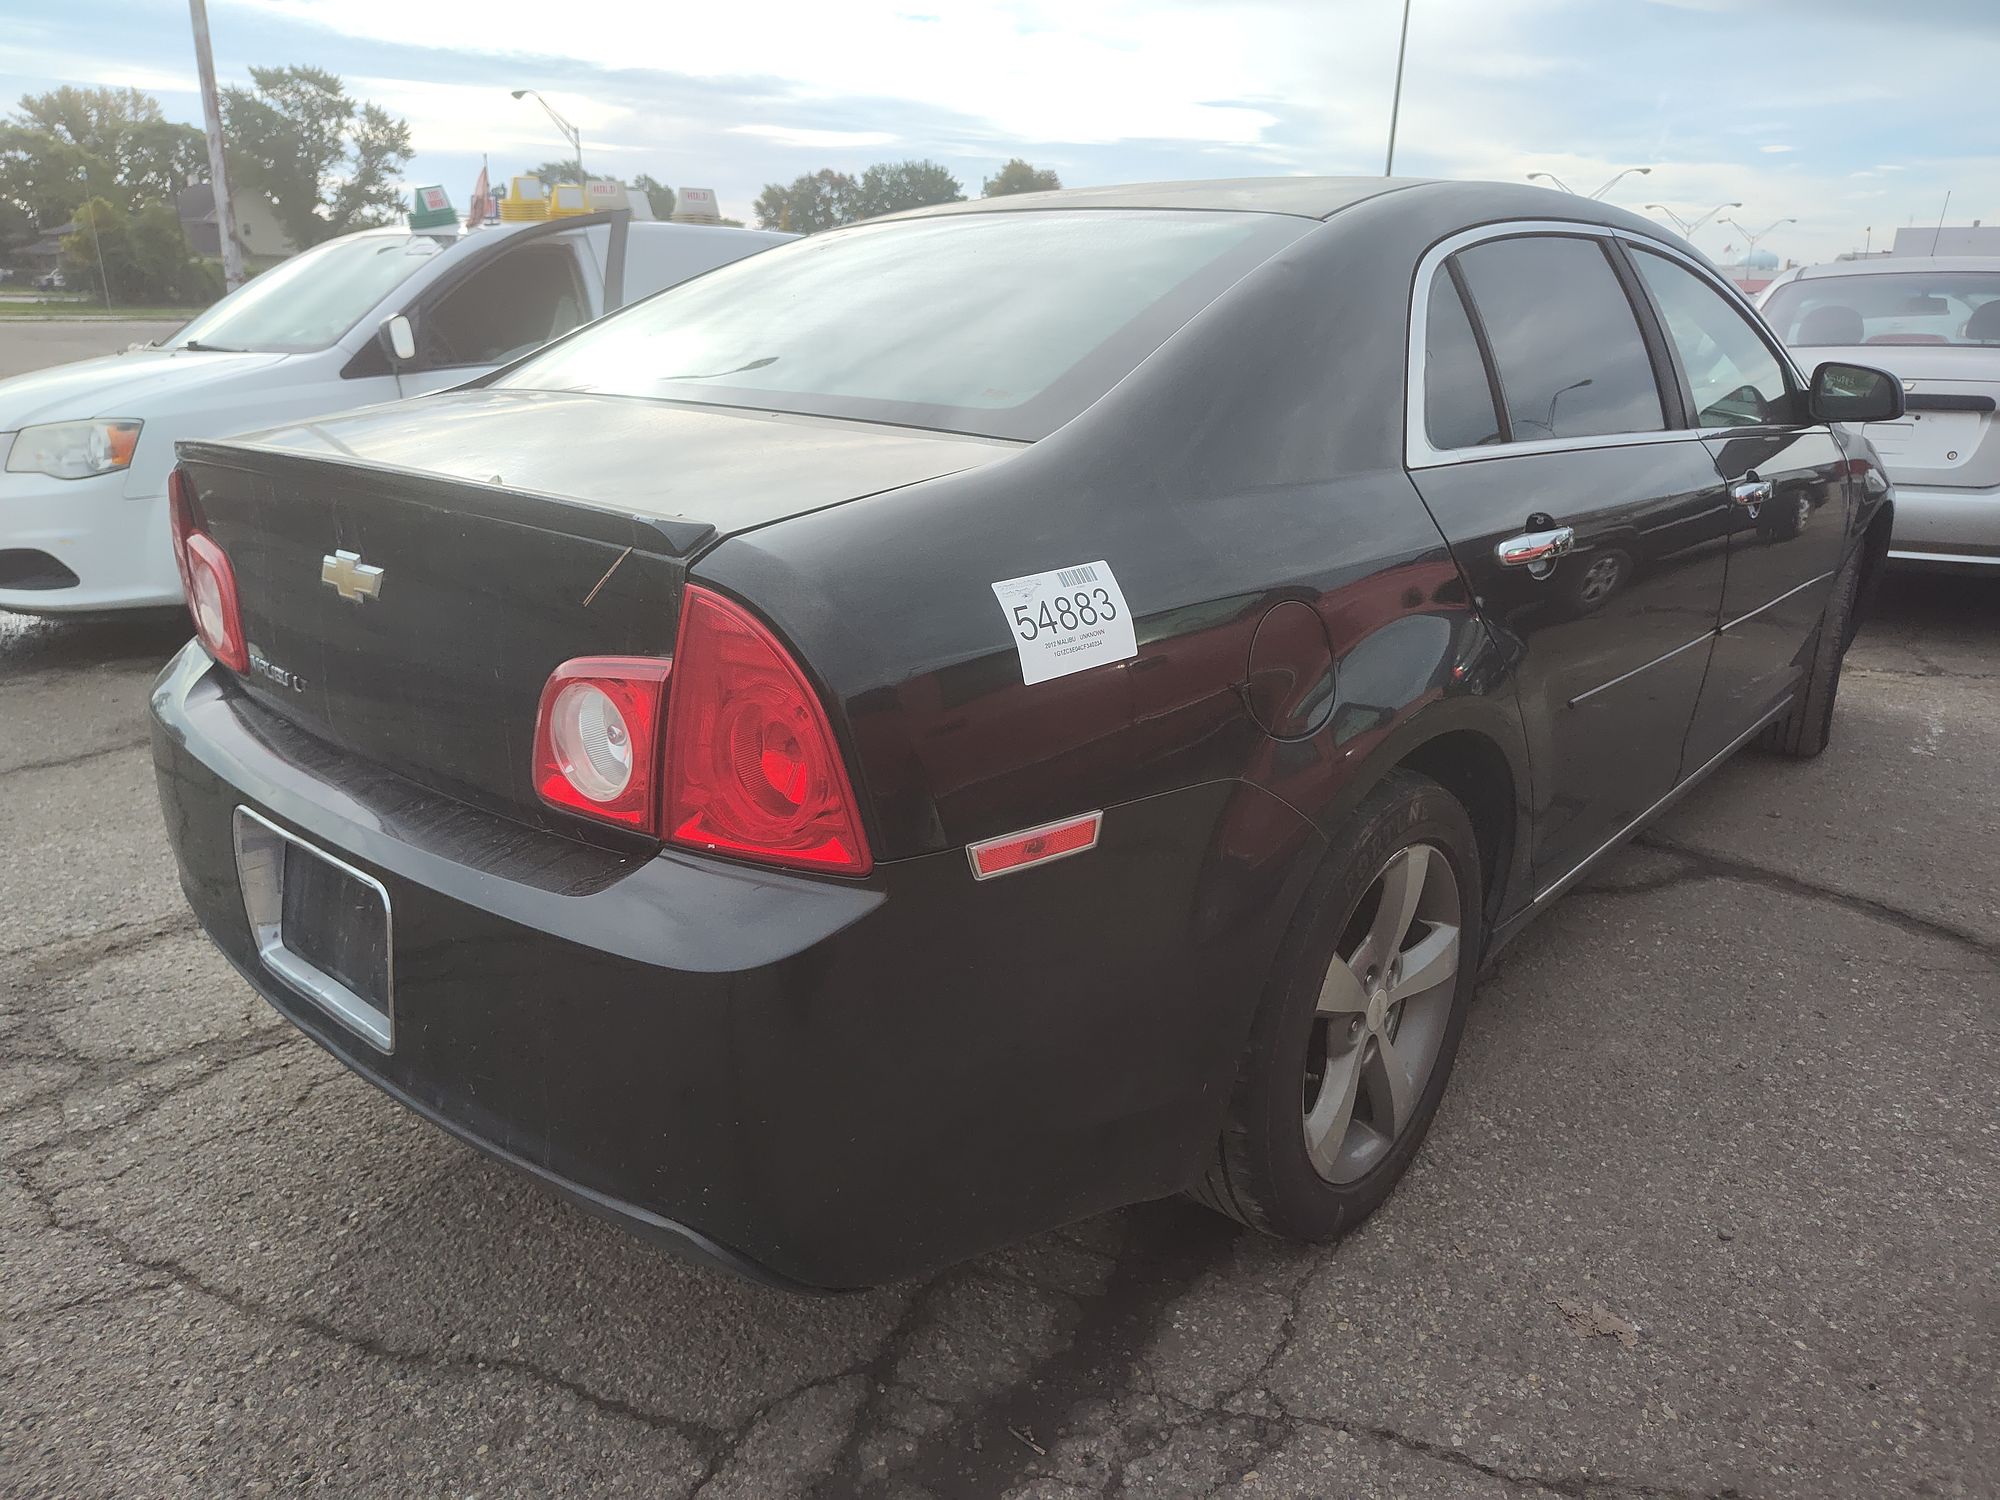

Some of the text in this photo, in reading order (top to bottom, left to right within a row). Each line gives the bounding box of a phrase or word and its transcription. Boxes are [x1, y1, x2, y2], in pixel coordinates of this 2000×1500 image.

[1013, 587, 1117, 641] 54883
[1045, 629, 1106, 649] 2012 MALIBU UNKNOWN
